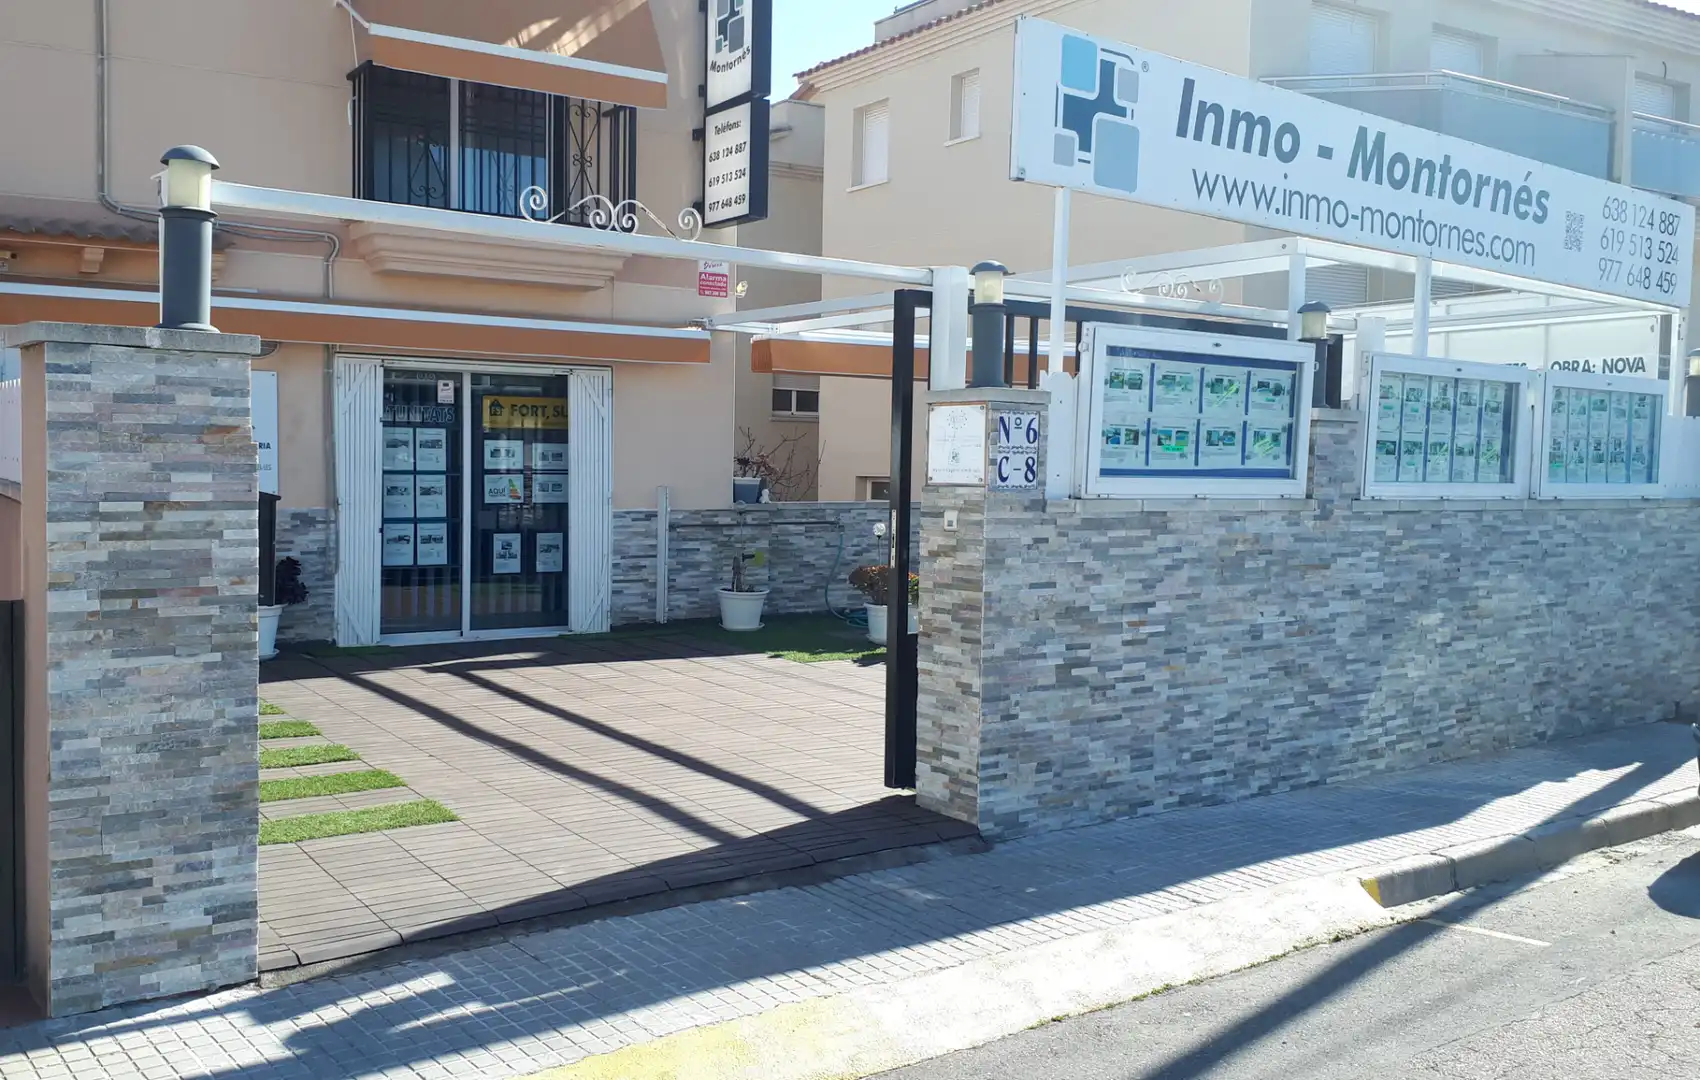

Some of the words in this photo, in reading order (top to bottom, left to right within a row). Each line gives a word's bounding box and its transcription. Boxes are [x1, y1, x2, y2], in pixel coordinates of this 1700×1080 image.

[709, 150, 720, 163] 638
[722, 146, 733, 158] 124
[735, 141, 747, 154] 887
[1176, 77, 1301, 164] Inmo
[1346, 125, 1550, 225] Montornés
[709, 176, 720, 188] 619
[721, 171, 733, 184] 513
[734, 167, 746, 180] 524
[709, 200, 720, 212] 977
[721, 197, 732, 209] 648
[734, 193, 746, 205] 459
[1602, 195, 1628, 224] 638
[1632, 203, 1655, 231] 124
[1658, 210, 1681, 237] 887
[1191, 168, 1536, 267] www.inmo-montornes.com
[1600, 226, 1625, 254] 619
[1628, 233, 1653, 260] 513
[1657, 240, 1680, 265] 524
[1598, 256, 1623, 283] 977
[1626, 263, 1652, 290] 648
[1655, 270, 1678, 296] 459
[1602, 356, 1647, 374] NOVA
[511, 404, 549, 419] FORT,
[1025, 417, 1038, 445] 6
